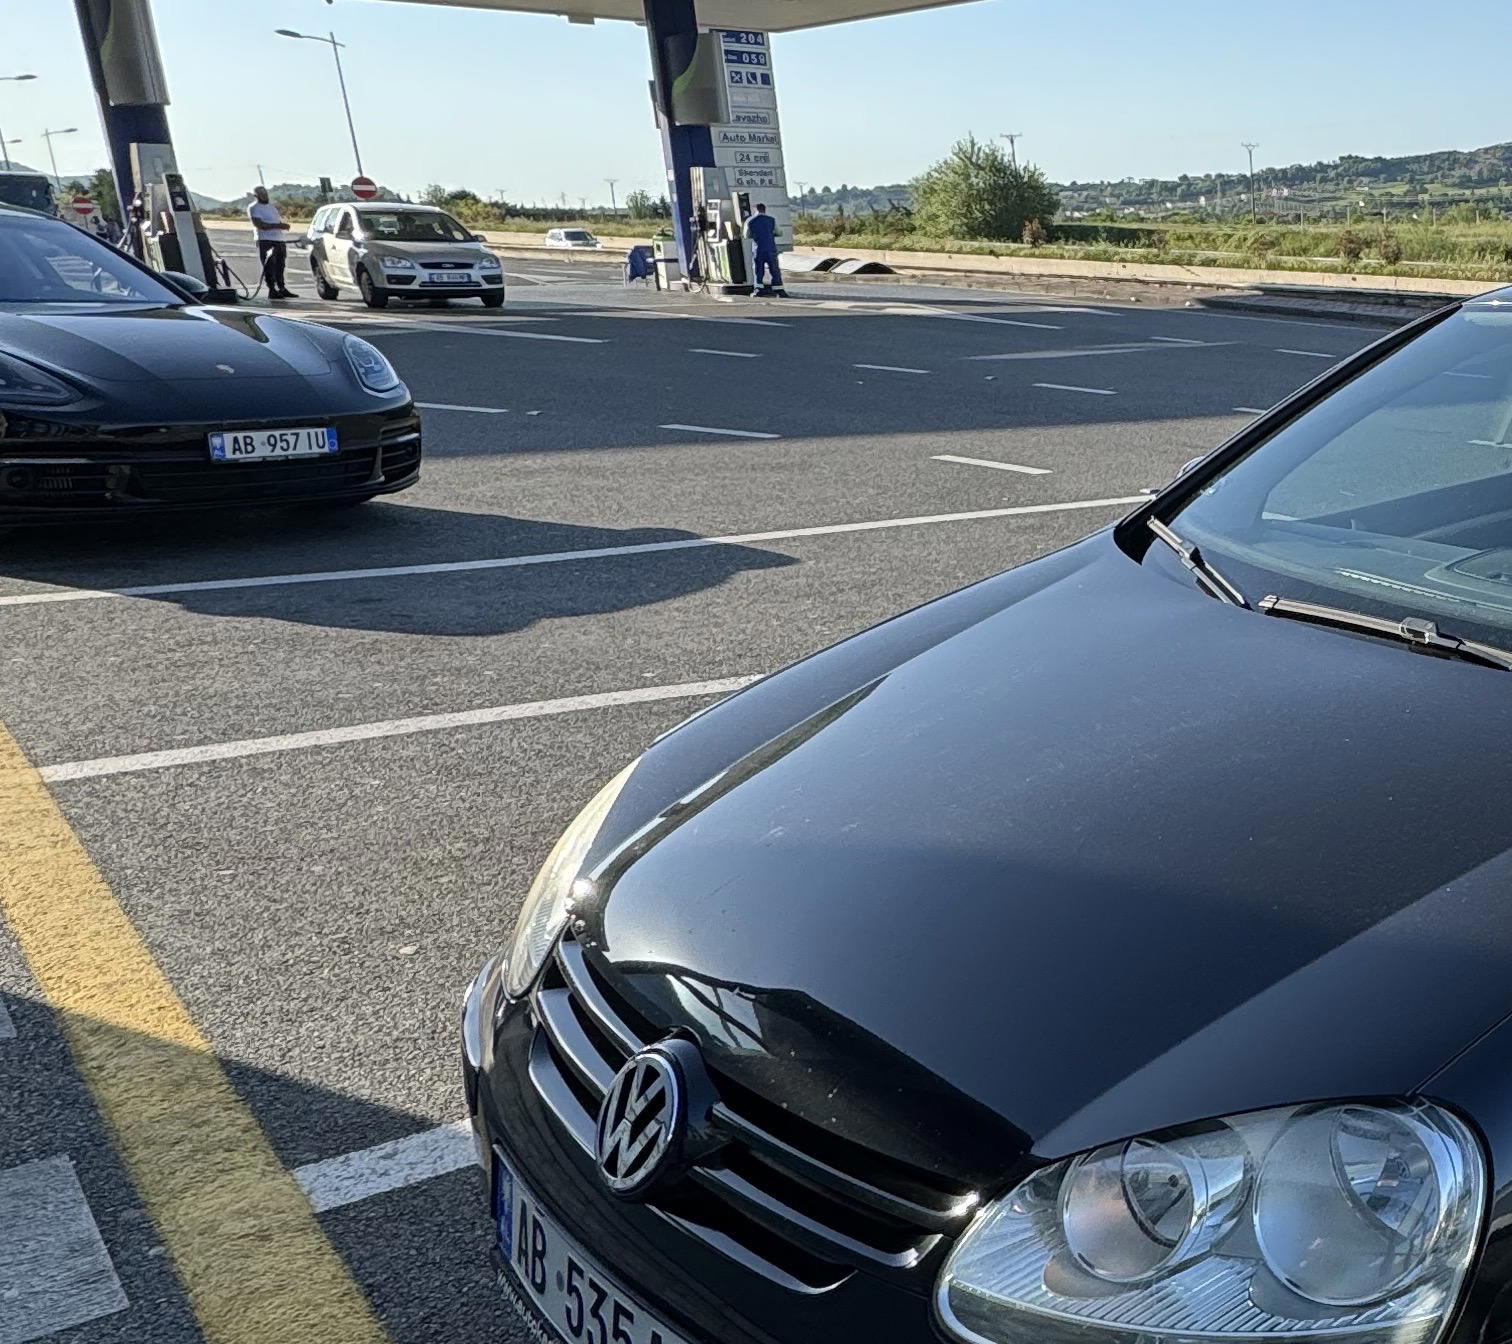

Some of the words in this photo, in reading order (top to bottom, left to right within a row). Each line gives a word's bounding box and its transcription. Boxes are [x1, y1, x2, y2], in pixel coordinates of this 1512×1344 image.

[722, 132, 746, 143] Auto
[739, 153, 751, 162] 24
[232, 435, 256, 455] AB
[267, 432, 300, 453] 957
[306, 430, 326, 450] IU
[517, 1198, 547, 1295] AB
